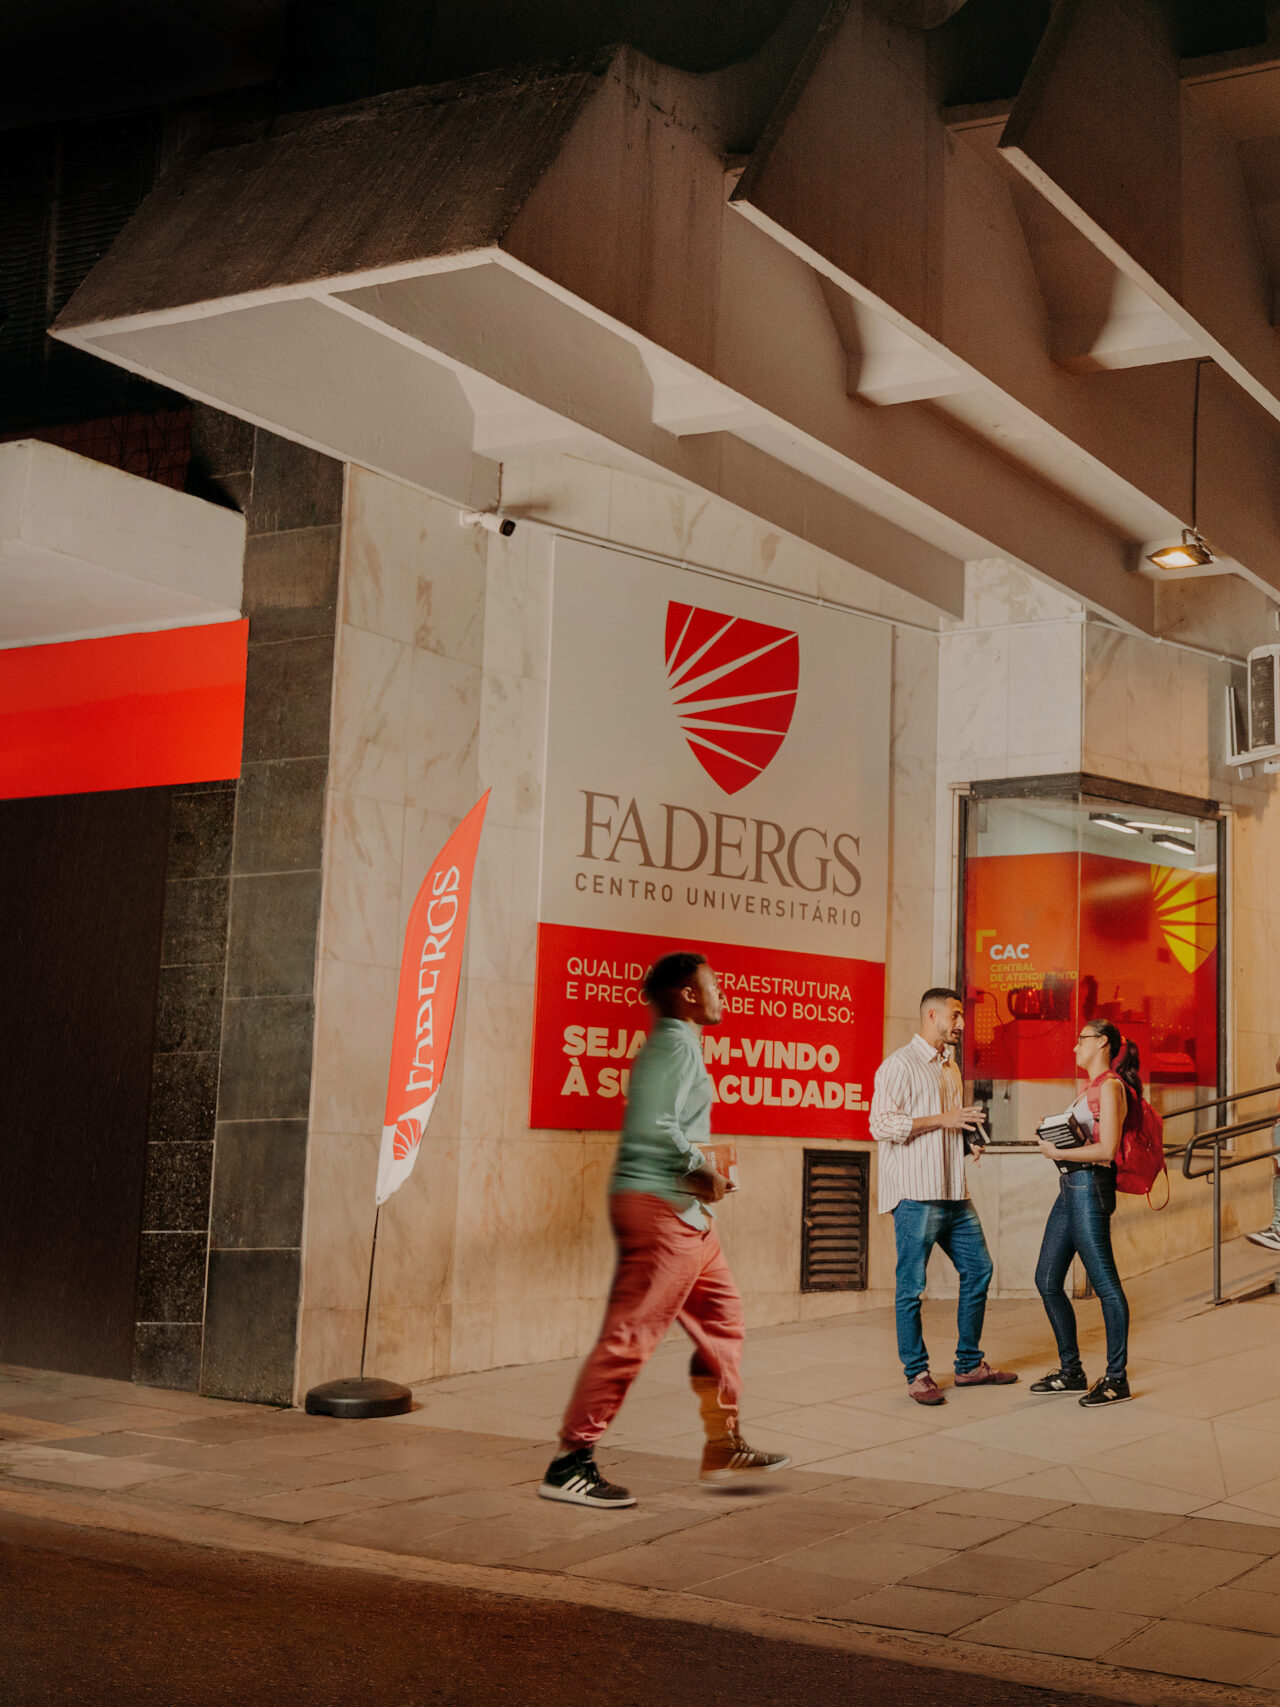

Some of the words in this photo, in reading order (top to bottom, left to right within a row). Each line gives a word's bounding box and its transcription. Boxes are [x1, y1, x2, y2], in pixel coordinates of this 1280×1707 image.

[576, 789, 862, 897] FADERGS
[575, 873, 673, 902] CENTRO
[687, 887, 861, 927] UNIVERSITÁRIO
[989, 943, 1030, 960] CAC
[990, 963, 1035, 973] CENTRAL
[990, 974, 1005, 983] DE
[566, 982, 578, 999] E
[761, 999, 787, 1018] NO
[793, 1003, 854, 1024] BOLSO:
[561, 1057, 589, 1096] À
